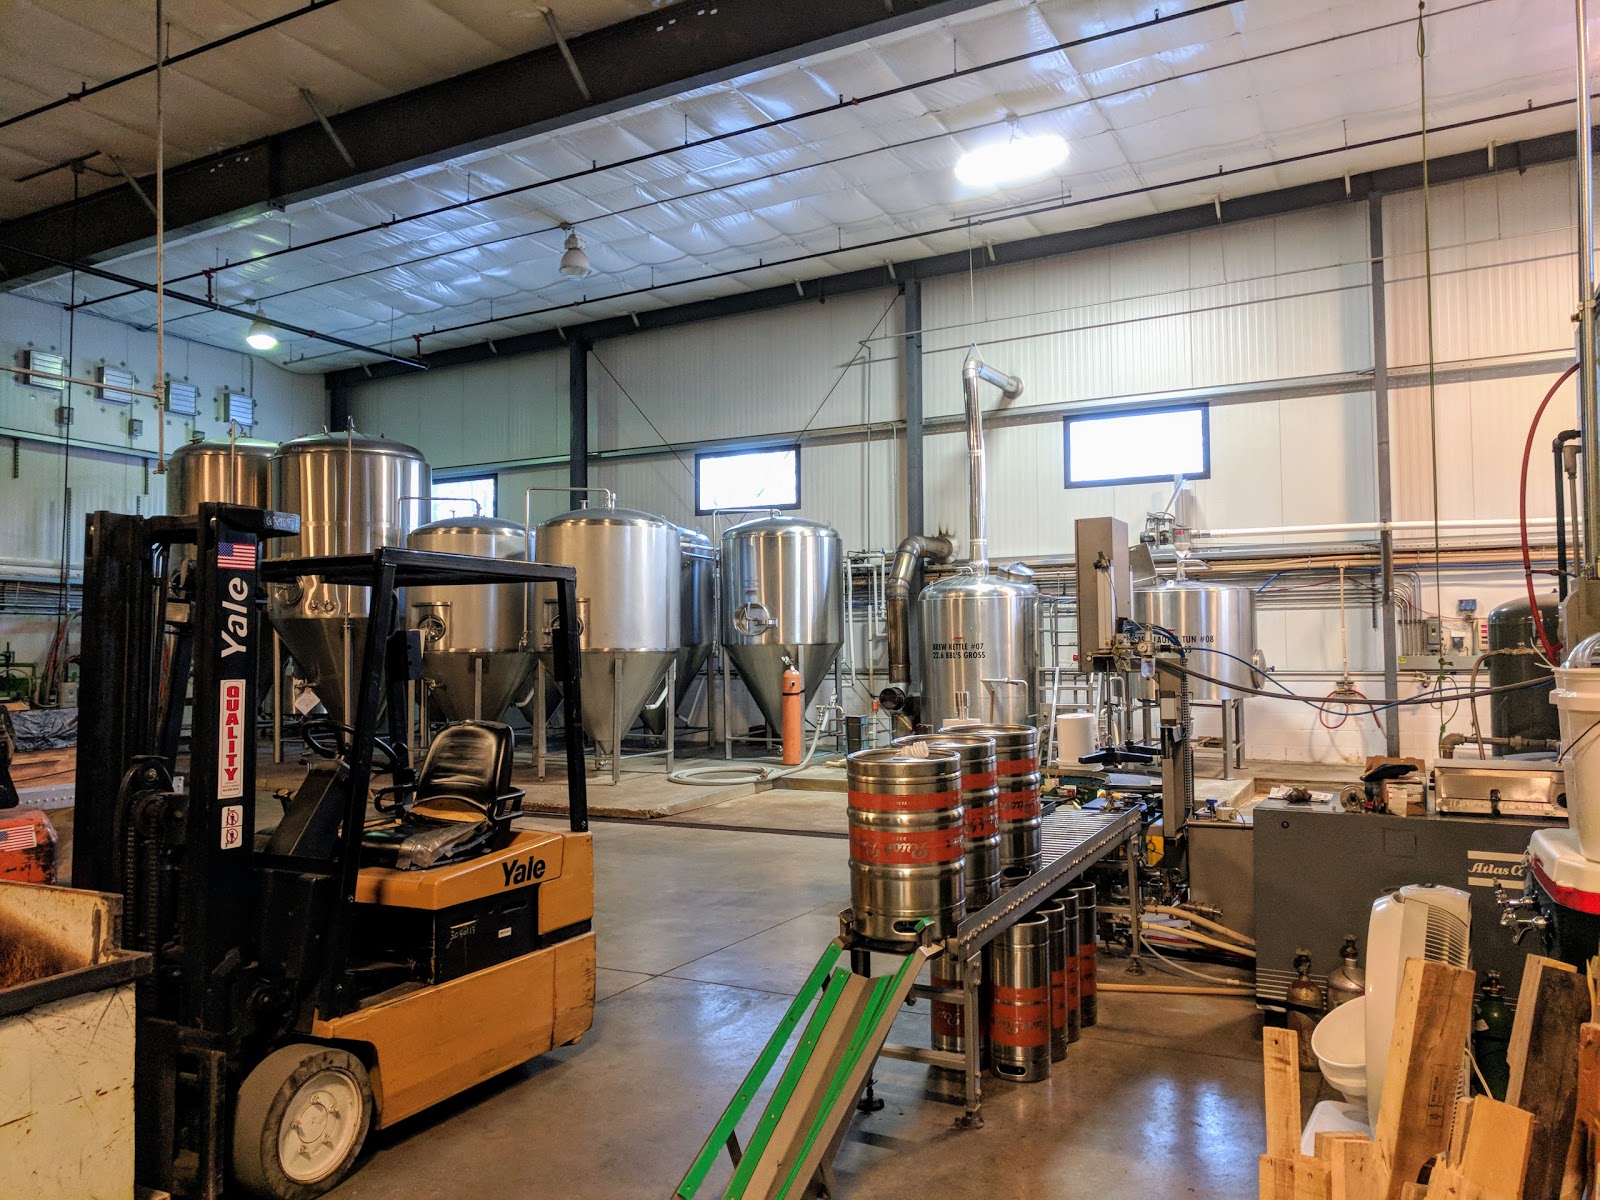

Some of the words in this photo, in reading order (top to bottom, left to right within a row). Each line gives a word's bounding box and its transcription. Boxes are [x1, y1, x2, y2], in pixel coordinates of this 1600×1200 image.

[221, 577, 249, 658] Yale
[1182, 635, 1197, 643] TUN
[1199, 635, 1215, 643] #08
[933, 643, 947, 651] BREW
[949, 643, 968, 651] KETTLE
[970, 642, 984, 650] #07
[963, 651, 986, 659] GROSS
[224, 685, 240, 781] QUALITY
[502, 856, 546, 887] Yale
[1468, 862, 1509, 876] Atlas
